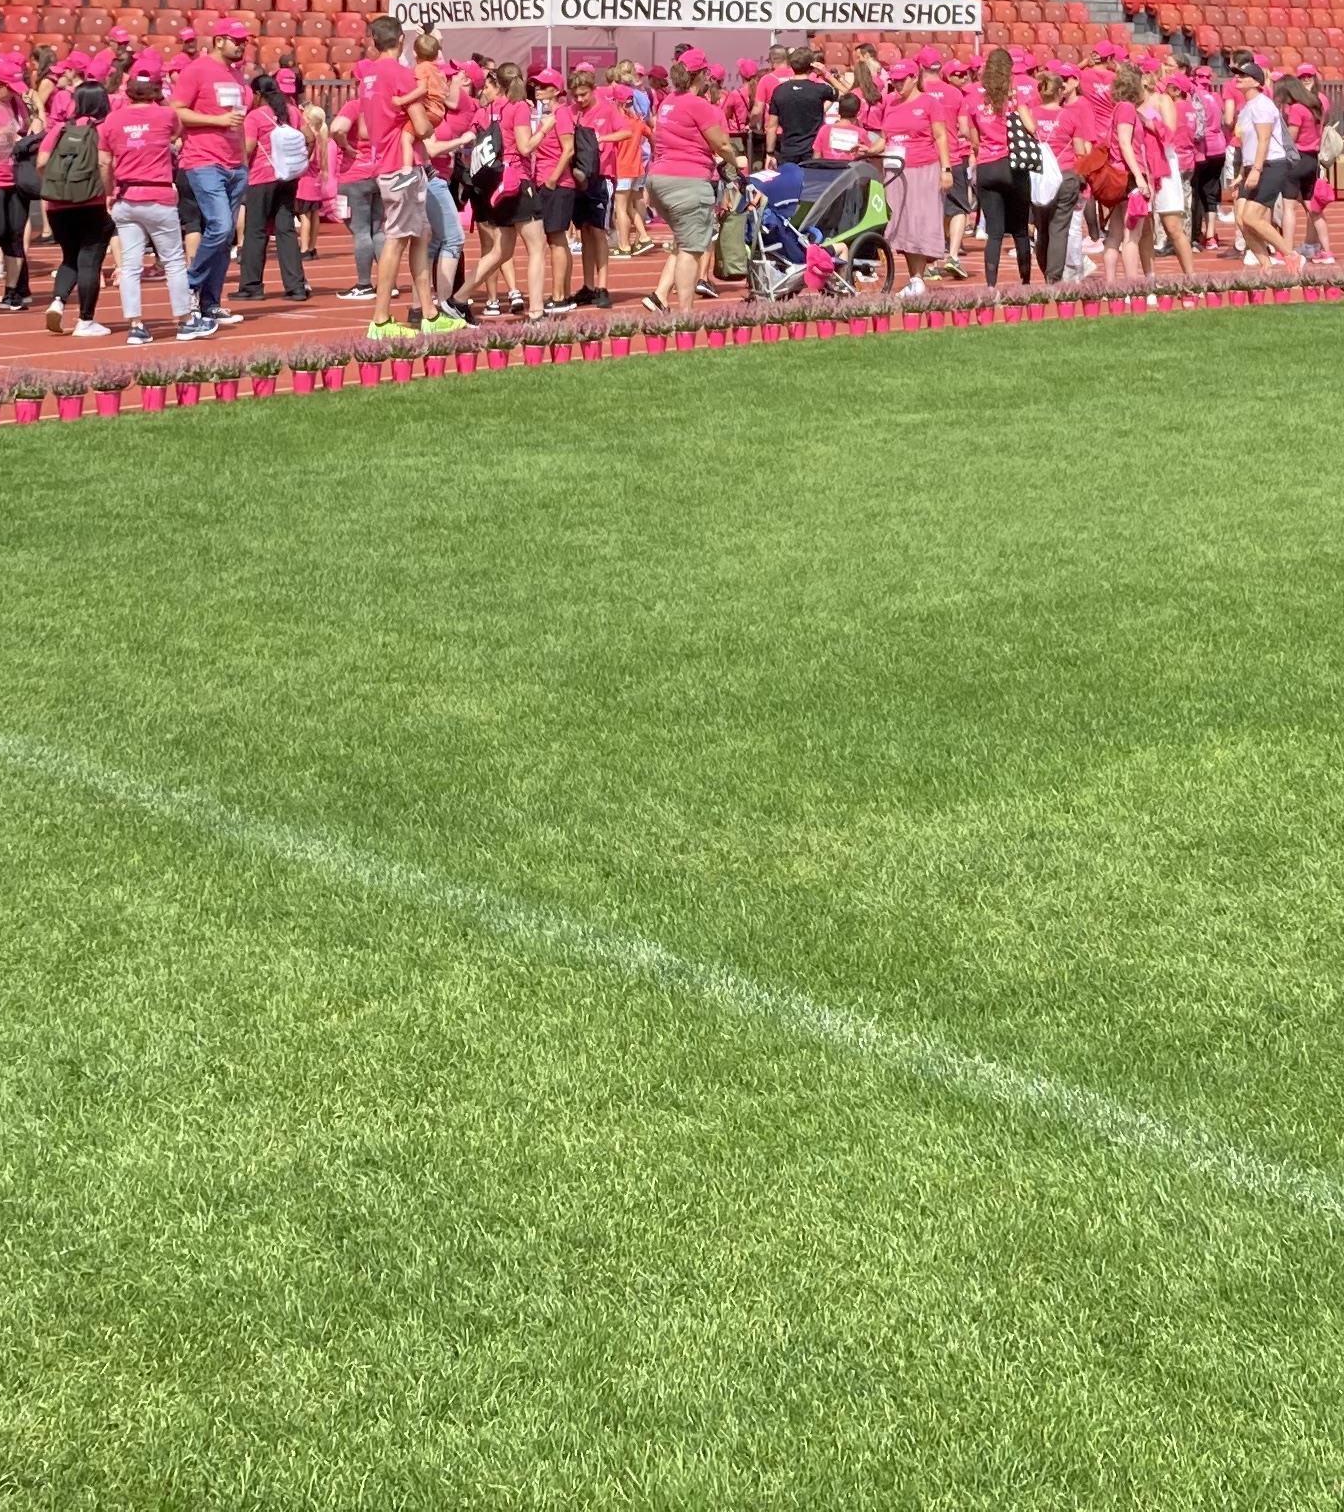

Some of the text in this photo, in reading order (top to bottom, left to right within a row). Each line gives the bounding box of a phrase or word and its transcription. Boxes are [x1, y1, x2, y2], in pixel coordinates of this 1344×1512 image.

[395, 0, 475, 25] OCHSNER
[691, 0, 773, 23] SHOES
[785, 1, 976, 25] OCHSNER SHOES
[122, 123, 150, 133] WALK
